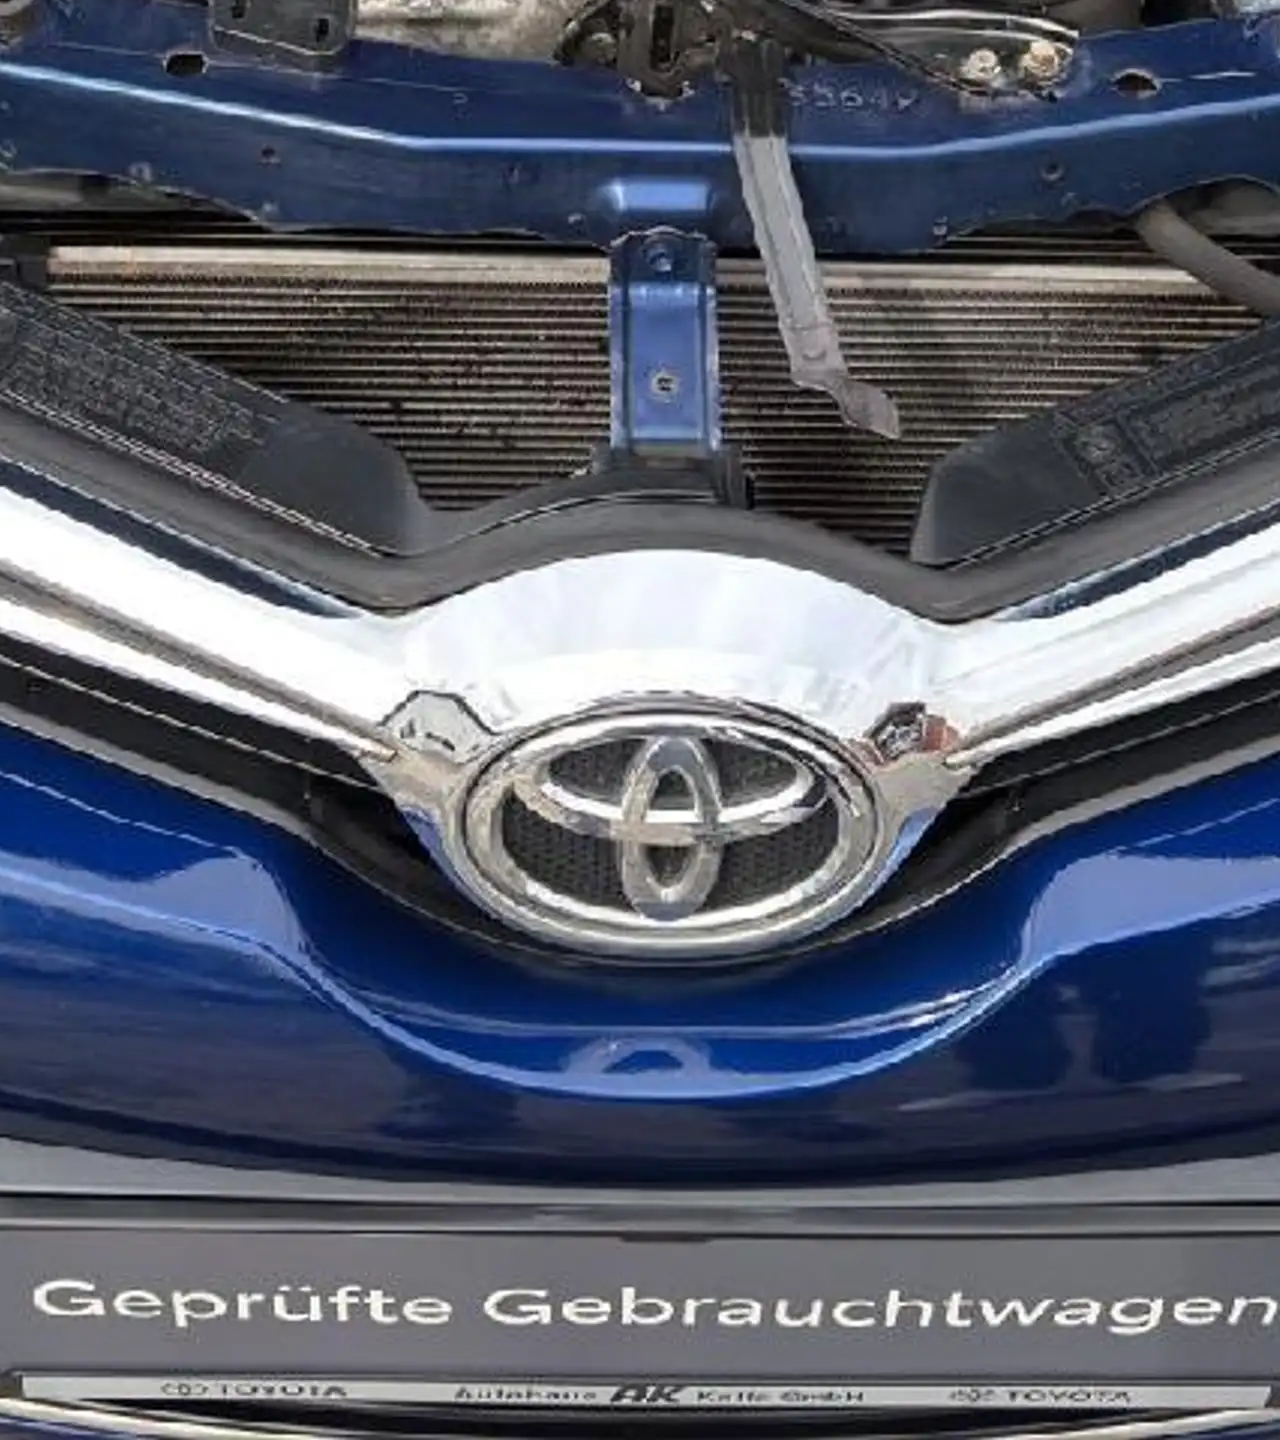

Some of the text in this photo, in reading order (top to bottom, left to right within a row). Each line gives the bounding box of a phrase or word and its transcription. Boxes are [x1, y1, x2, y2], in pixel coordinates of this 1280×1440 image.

[32, 1279, 1279, 1336] Geprüfte Gebrauchtwagen
[215, 1382, 348, 1397] TOYOTA
[610, 1383, 685, 1403] AK
[1006, 1390, 1133, 1404] TOYOTA
